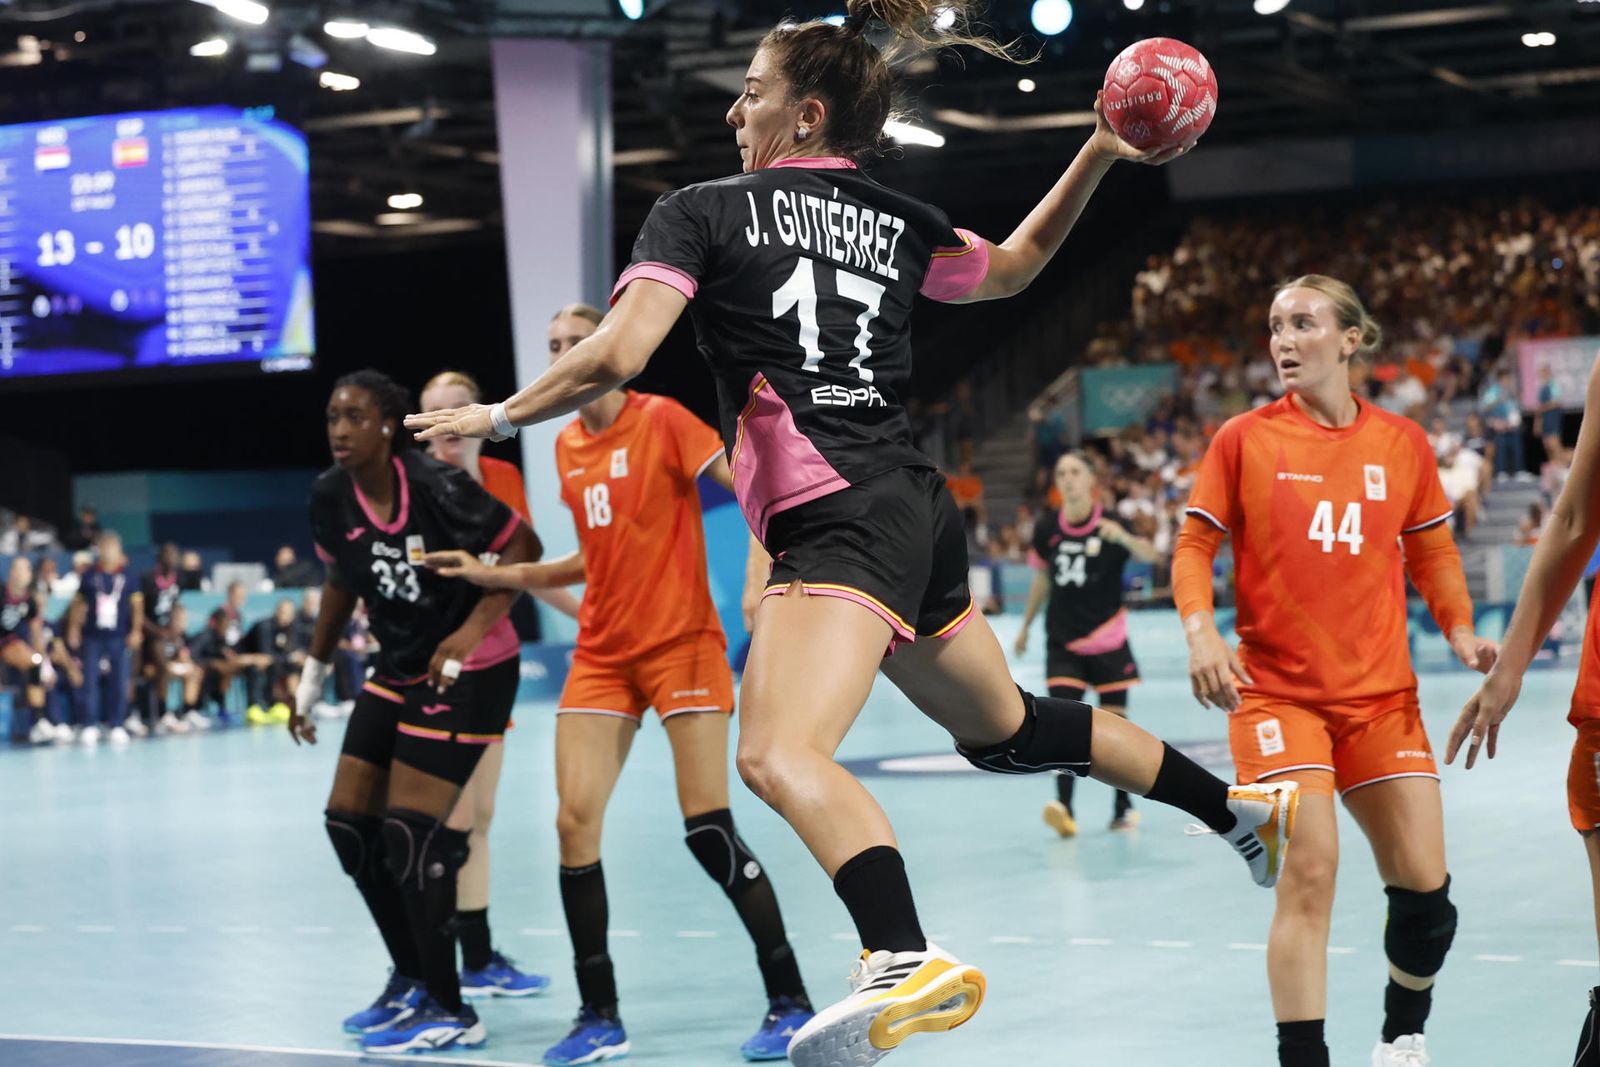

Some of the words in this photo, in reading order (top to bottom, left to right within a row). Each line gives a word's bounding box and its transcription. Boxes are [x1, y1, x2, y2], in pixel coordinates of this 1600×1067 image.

[37, 229, 76, 267] 13
[115, 222, 155, 260] 10
[745, 191, 770, 247] J.
[772, 186, 905, 281] GUTIÉRREZ
[772, 256, 886, 383] 17
[810, 384, 888, 407] ESPA
[584, 482, 613, 529] 18
[1308, 500, 1364, 555] 44
[371, 559, 421, 602] 33
[1055, 554, 1087, 588] 34
